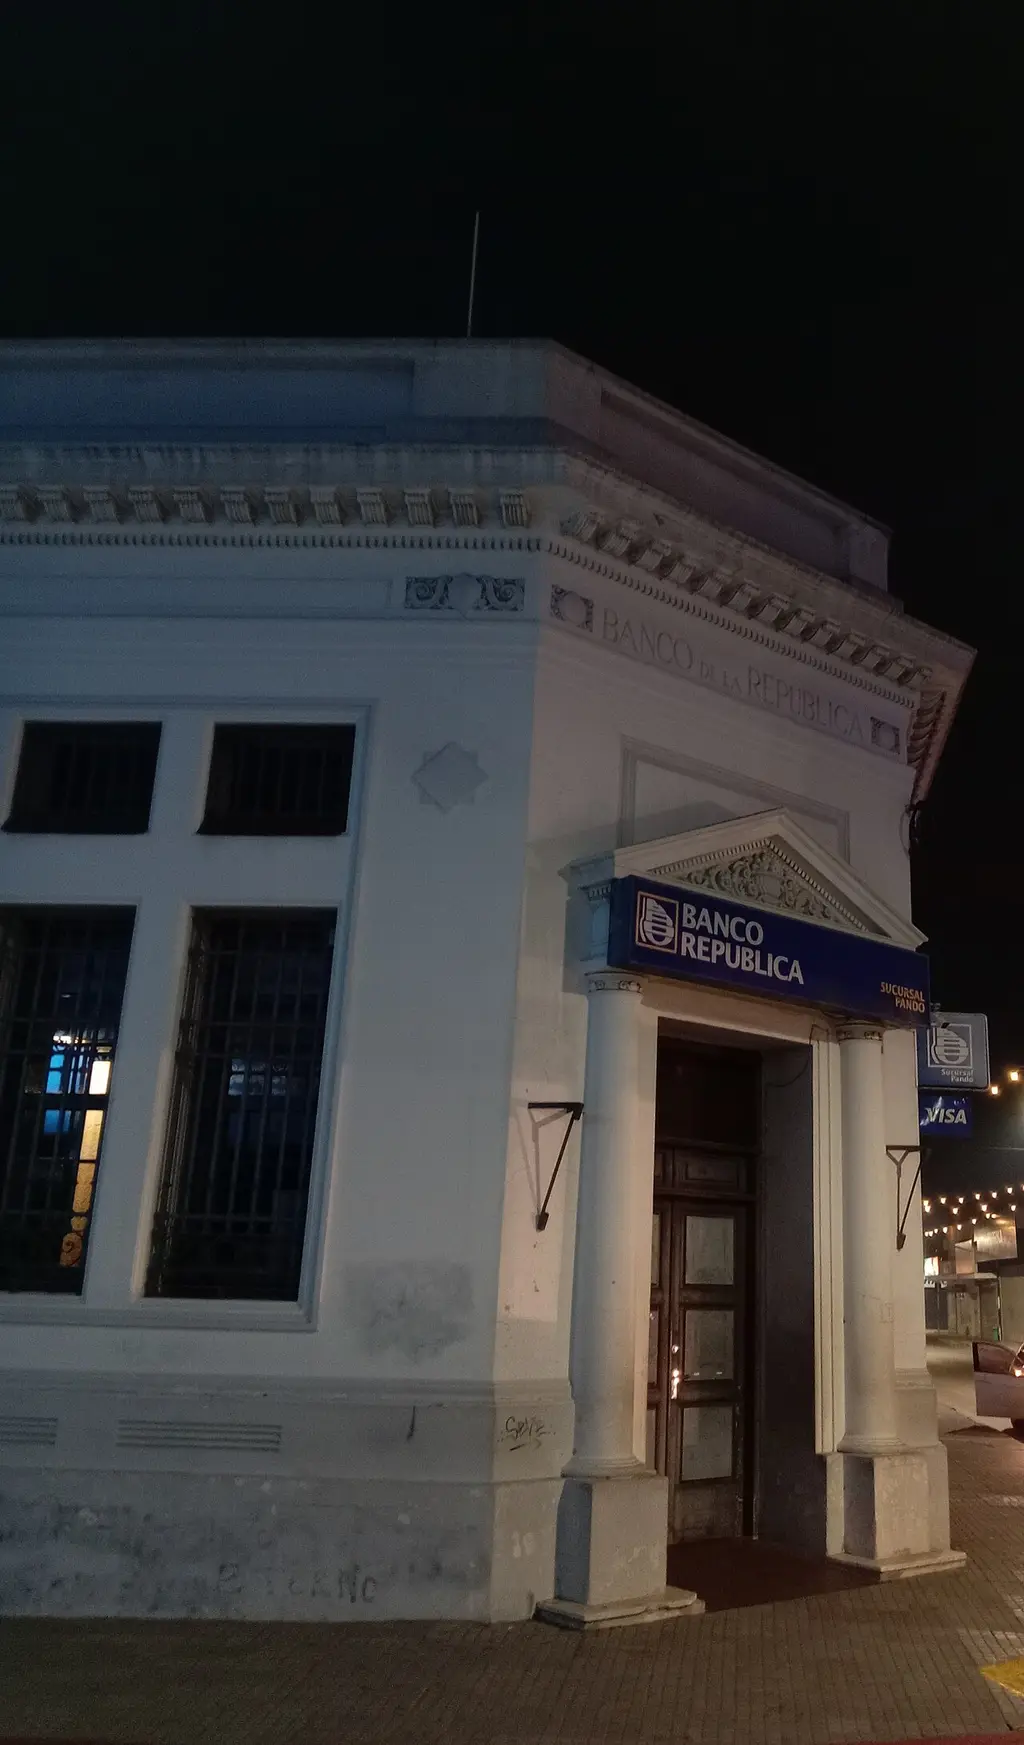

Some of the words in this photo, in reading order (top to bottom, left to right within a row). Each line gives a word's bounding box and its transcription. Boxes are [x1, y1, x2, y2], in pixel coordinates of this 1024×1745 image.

[603, 608, 693, 670] BANCO
[747, 666, 864, 741] REPUBLICA
[683, 903, 763, 945] BANCO
[681, 933, 803, 984] REPUBLICA
[880, 981, 925, 1002] SUCURSAL
[895, 999, 925, 1013] PANDO
[941, 1068, 974, 1077] Sucursal
[951, 1075, 974, 1083] Pando
[924, 1107, 967, 1125] VISA
